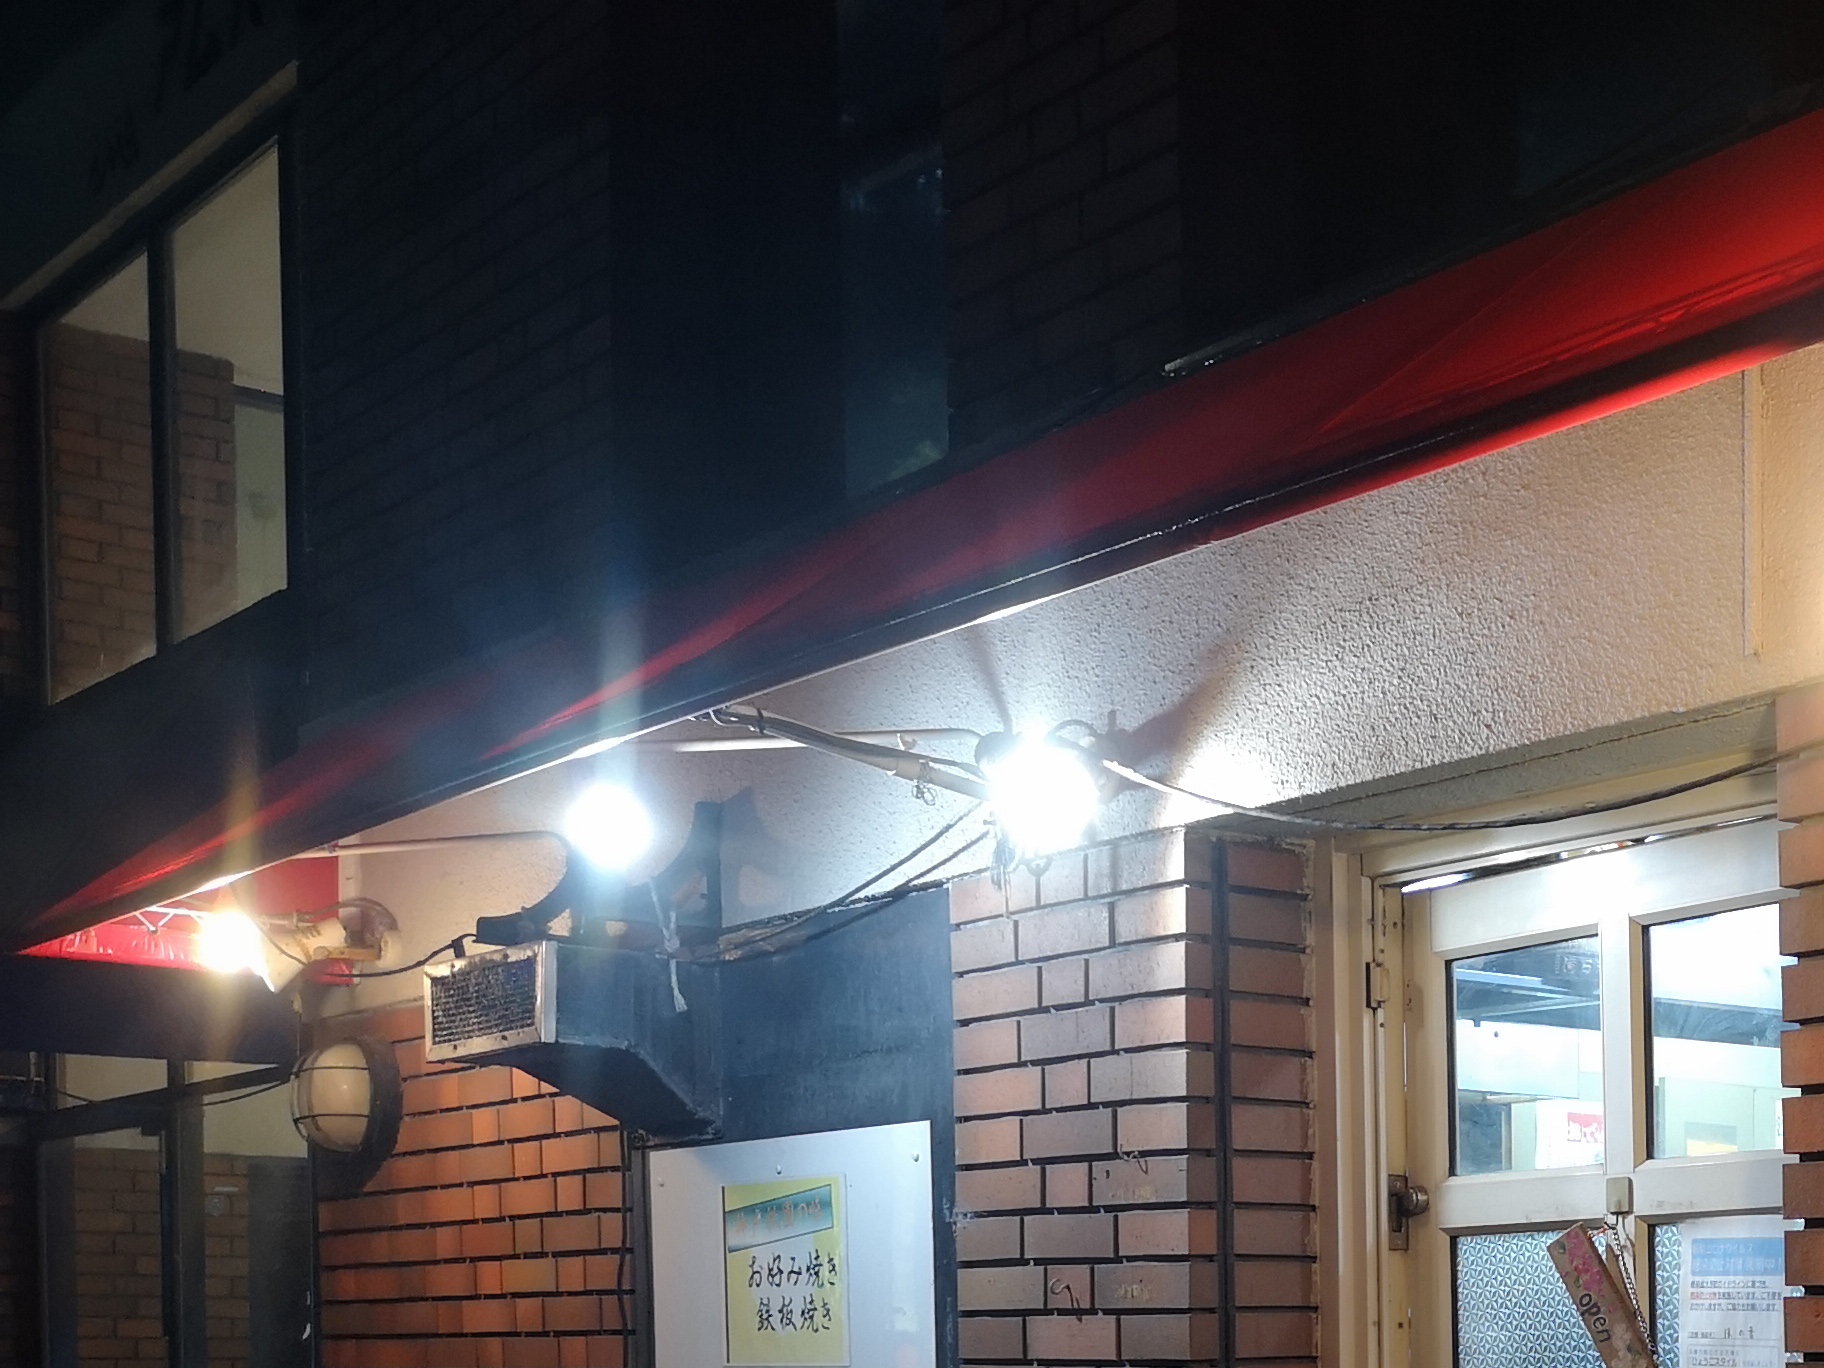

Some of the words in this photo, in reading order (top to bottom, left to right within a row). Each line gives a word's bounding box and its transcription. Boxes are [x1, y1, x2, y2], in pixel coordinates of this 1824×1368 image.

[748, 1248, 838, 1288] お好み焼き
[757, 1292, 832, 1333] 鉄板焼き
[1578, 1293, 1611, 1343] open
